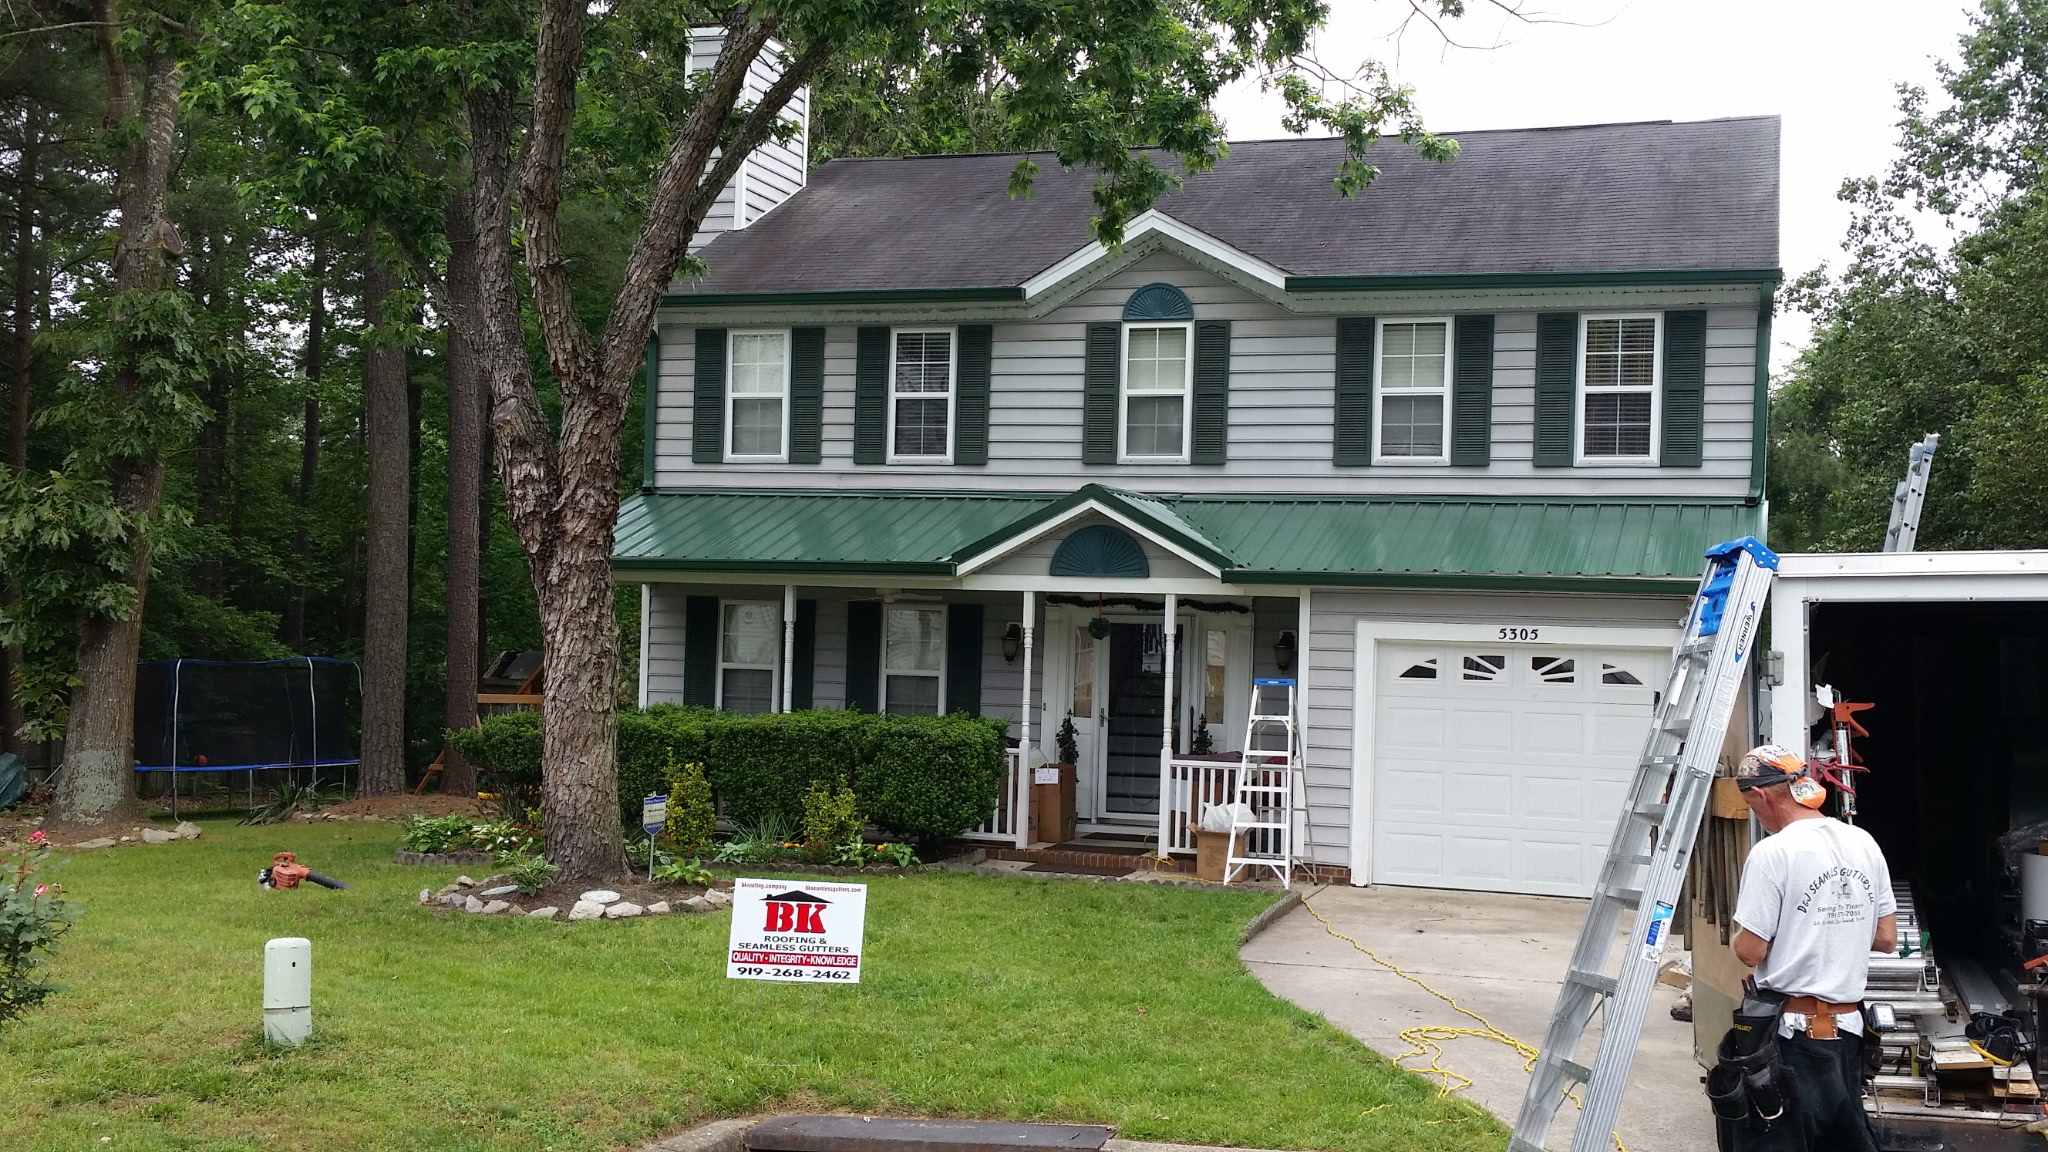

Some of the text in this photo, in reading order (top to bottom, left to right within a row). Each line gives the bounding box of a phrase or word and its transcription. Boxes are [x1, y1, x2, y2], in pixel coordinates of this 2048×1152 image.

[1498, 628, 1539, 640] 5305
[1738, 614, 1752, 651] WERNER
[763, 902, 827, 933] BK
[764, 935, 816, 944] ROOFING
[738, 942, 849, 953] SEAMLESS GUTTERS
[732, 952, 857, 966] QUALITY INTEGRITY KNOWLEDGE
[737, 967, 851, 979] 919-268-2462
